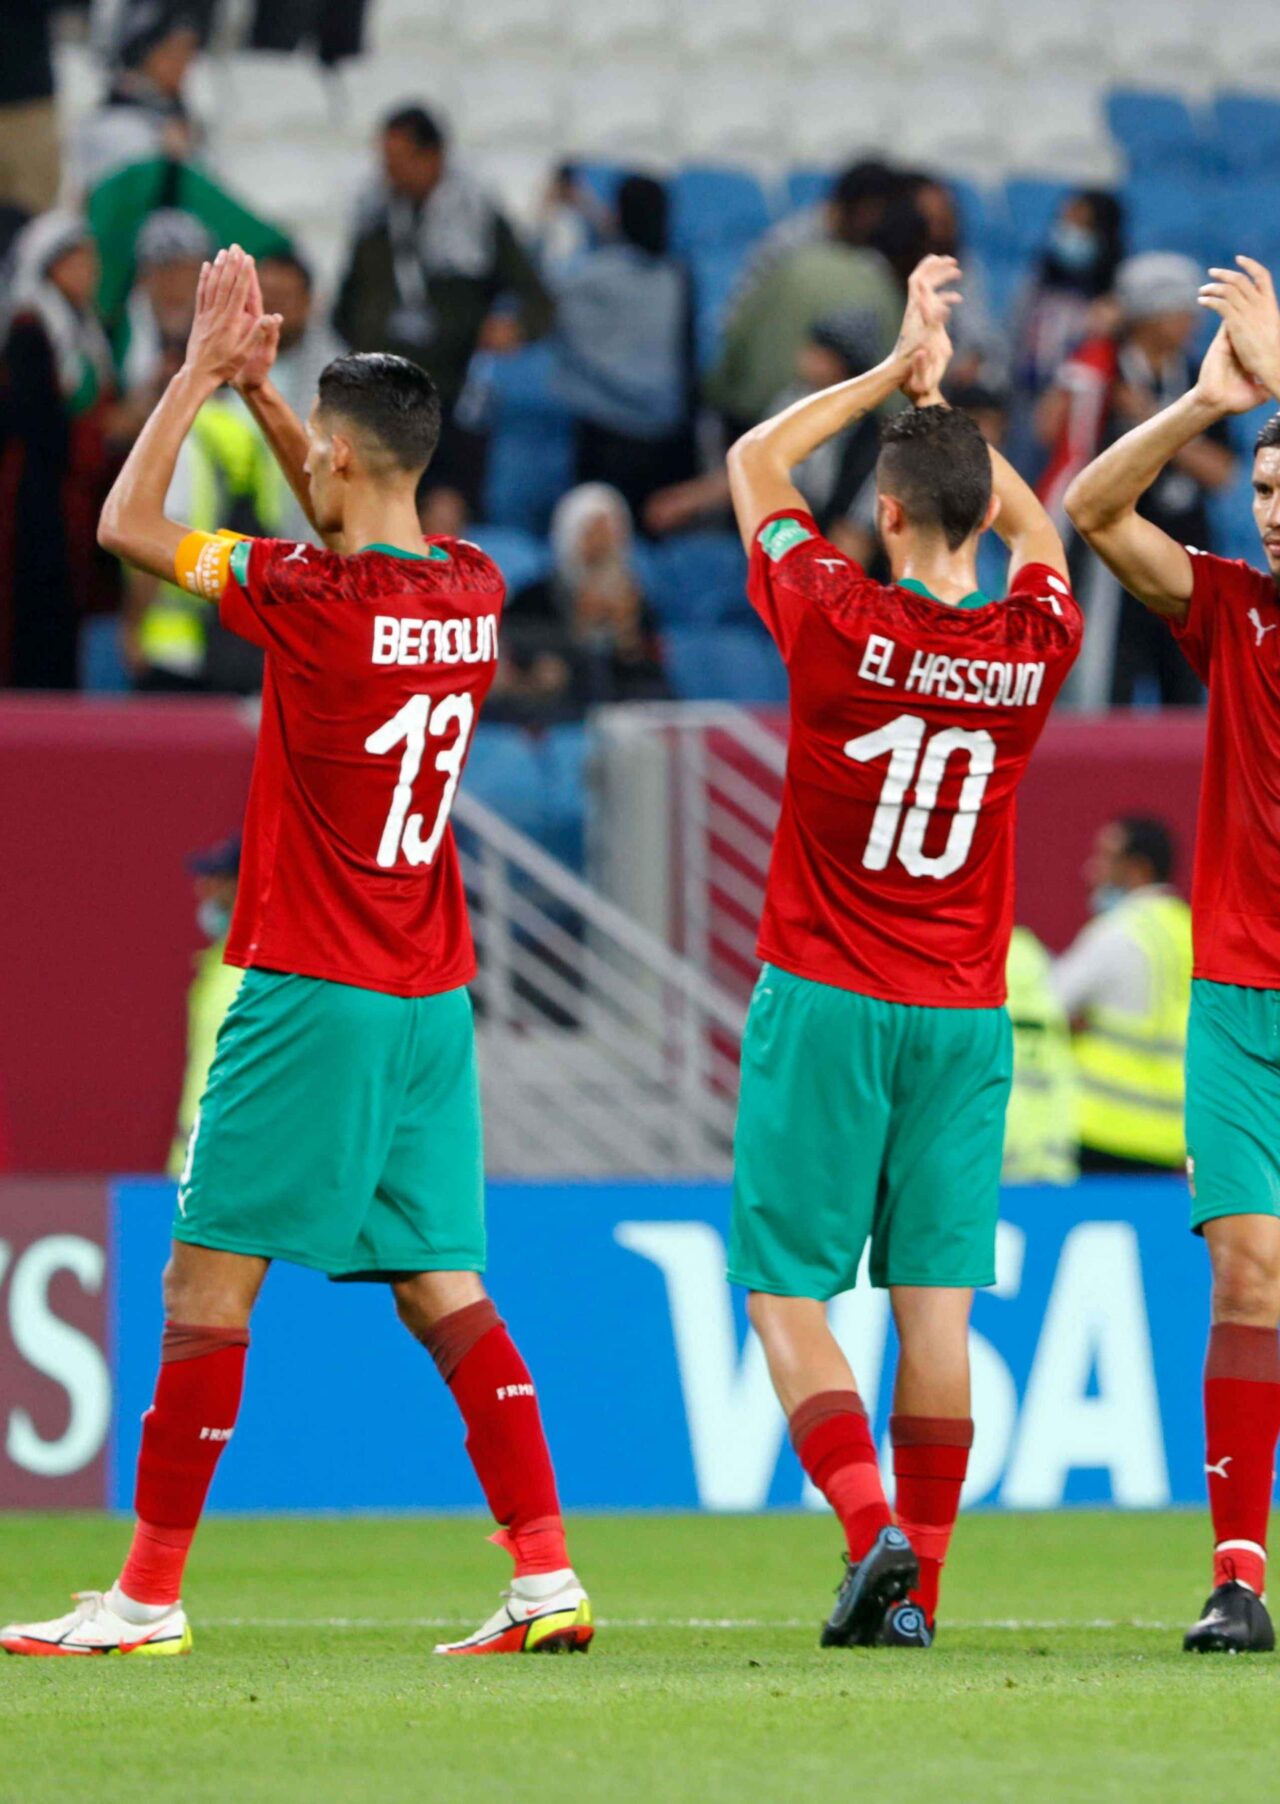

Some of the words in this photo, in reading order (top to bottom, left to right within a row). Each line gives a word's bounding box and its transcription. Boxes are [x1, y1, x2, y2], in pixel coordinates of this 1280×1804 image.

[857, 633, 896, 688] EL
[365, 692, 473, 867] 13
[844, 714, 997, 880] 10
[0, 1233, 112, 1478] S
